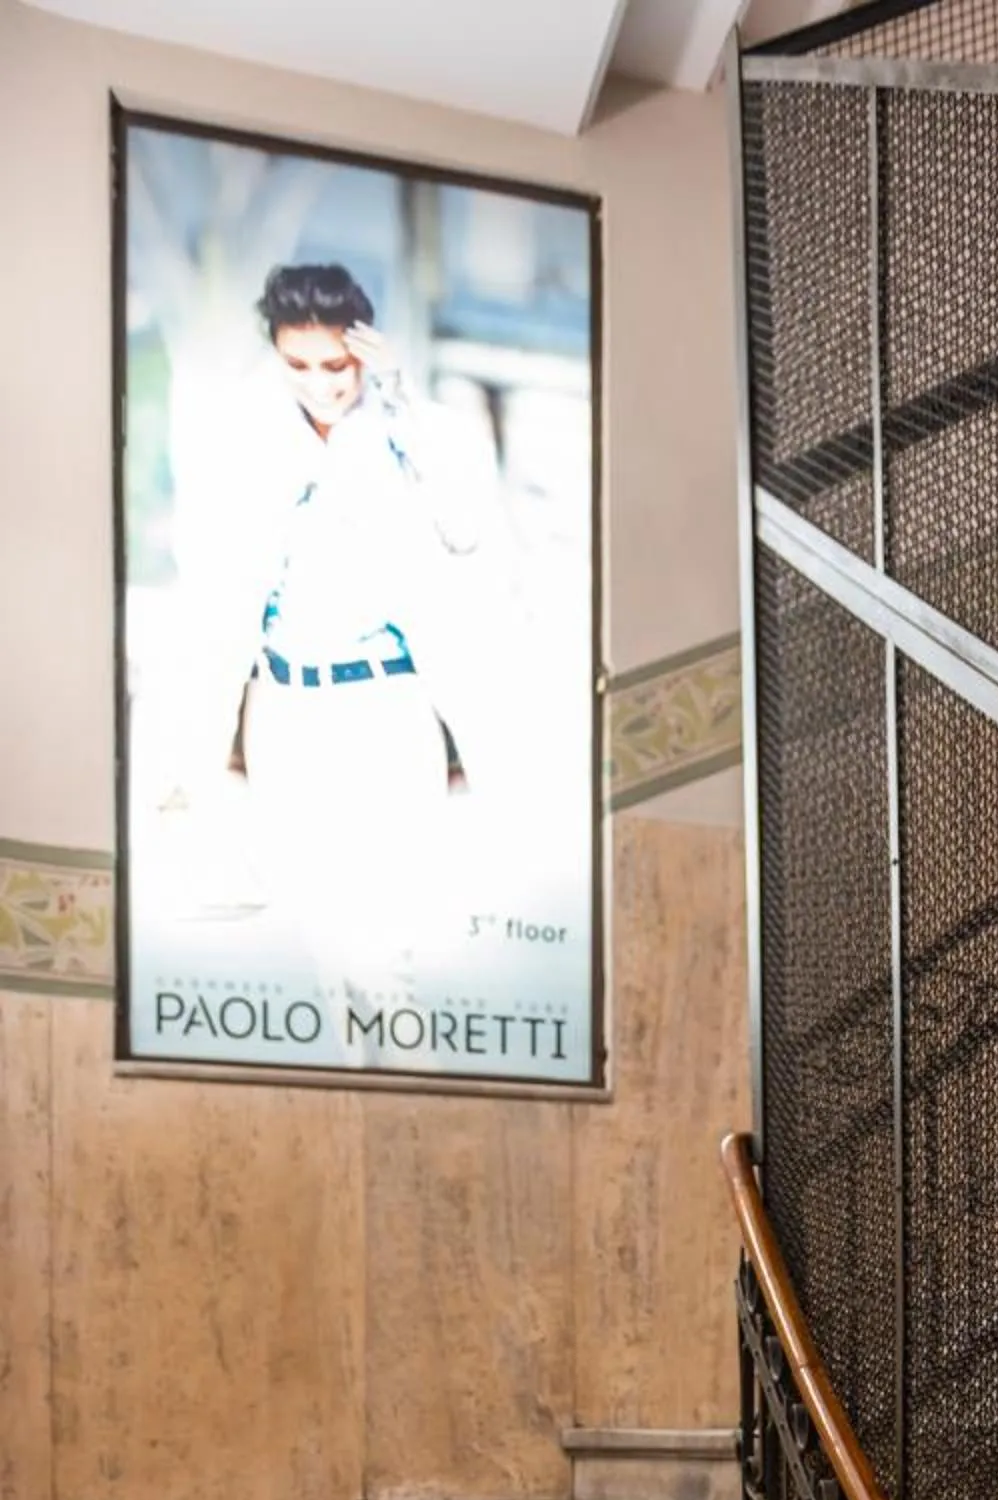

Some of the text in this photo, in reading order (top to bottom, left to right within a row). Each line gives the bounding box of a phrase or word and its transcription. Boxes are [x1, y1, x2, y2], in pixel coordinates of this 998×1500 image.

[505, 917, 568, 945] floor
[155, 992, 568, 1060] PAOLO MORETTI
